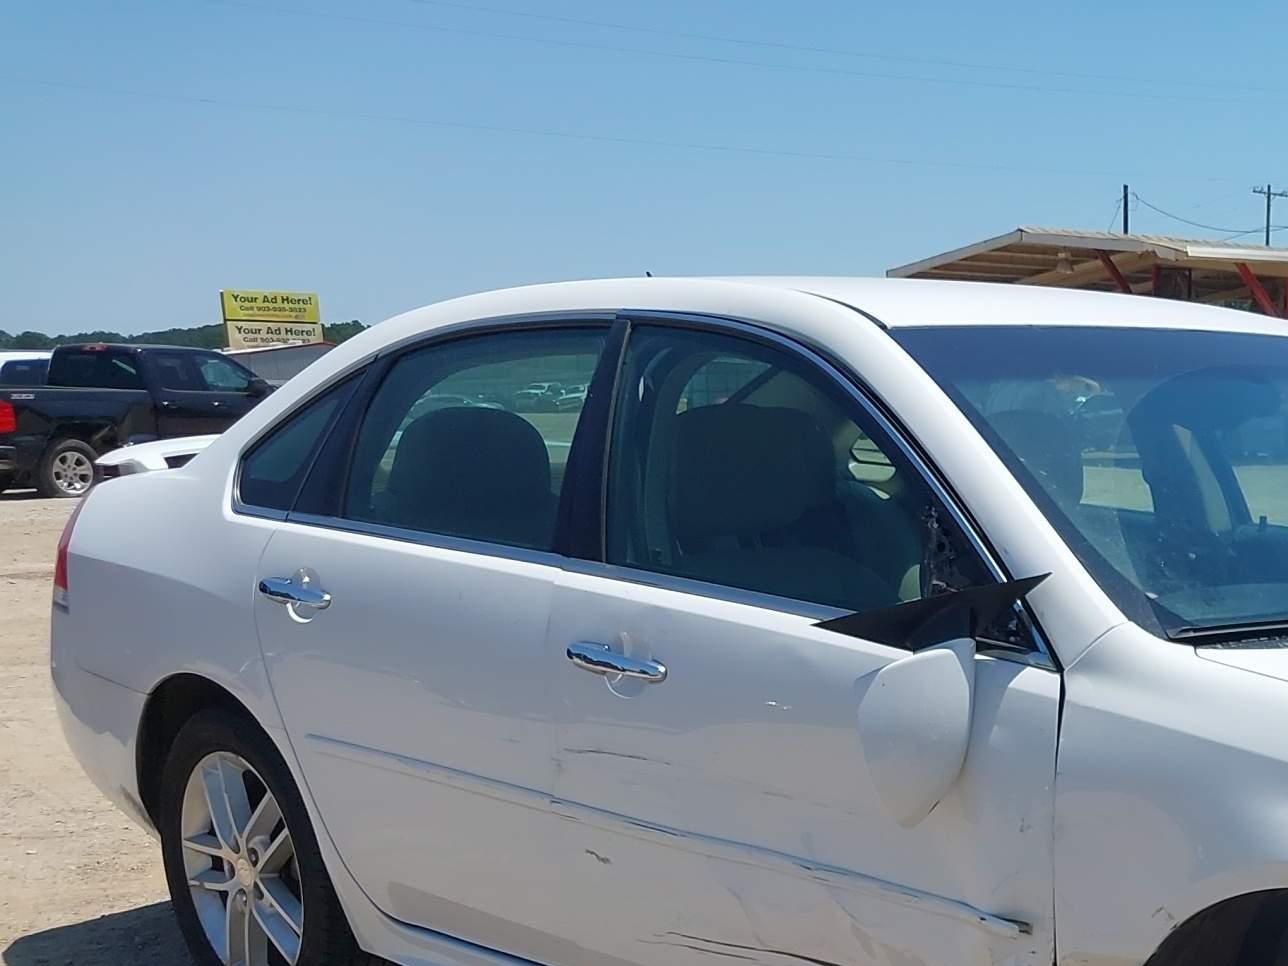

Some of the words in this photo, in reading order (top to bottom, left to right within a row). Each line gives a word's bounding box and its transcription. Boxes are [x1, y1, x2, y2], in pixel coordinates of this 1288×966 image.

[232, 294, 259, 304] Your
[262, 295, 278, 304] Ad
[281, 296, 313, 305] Here!
[235, 325, 262, 335] Your
[266, 326, 281, 335] Ad
[285, 327, 316, 336] Here!
